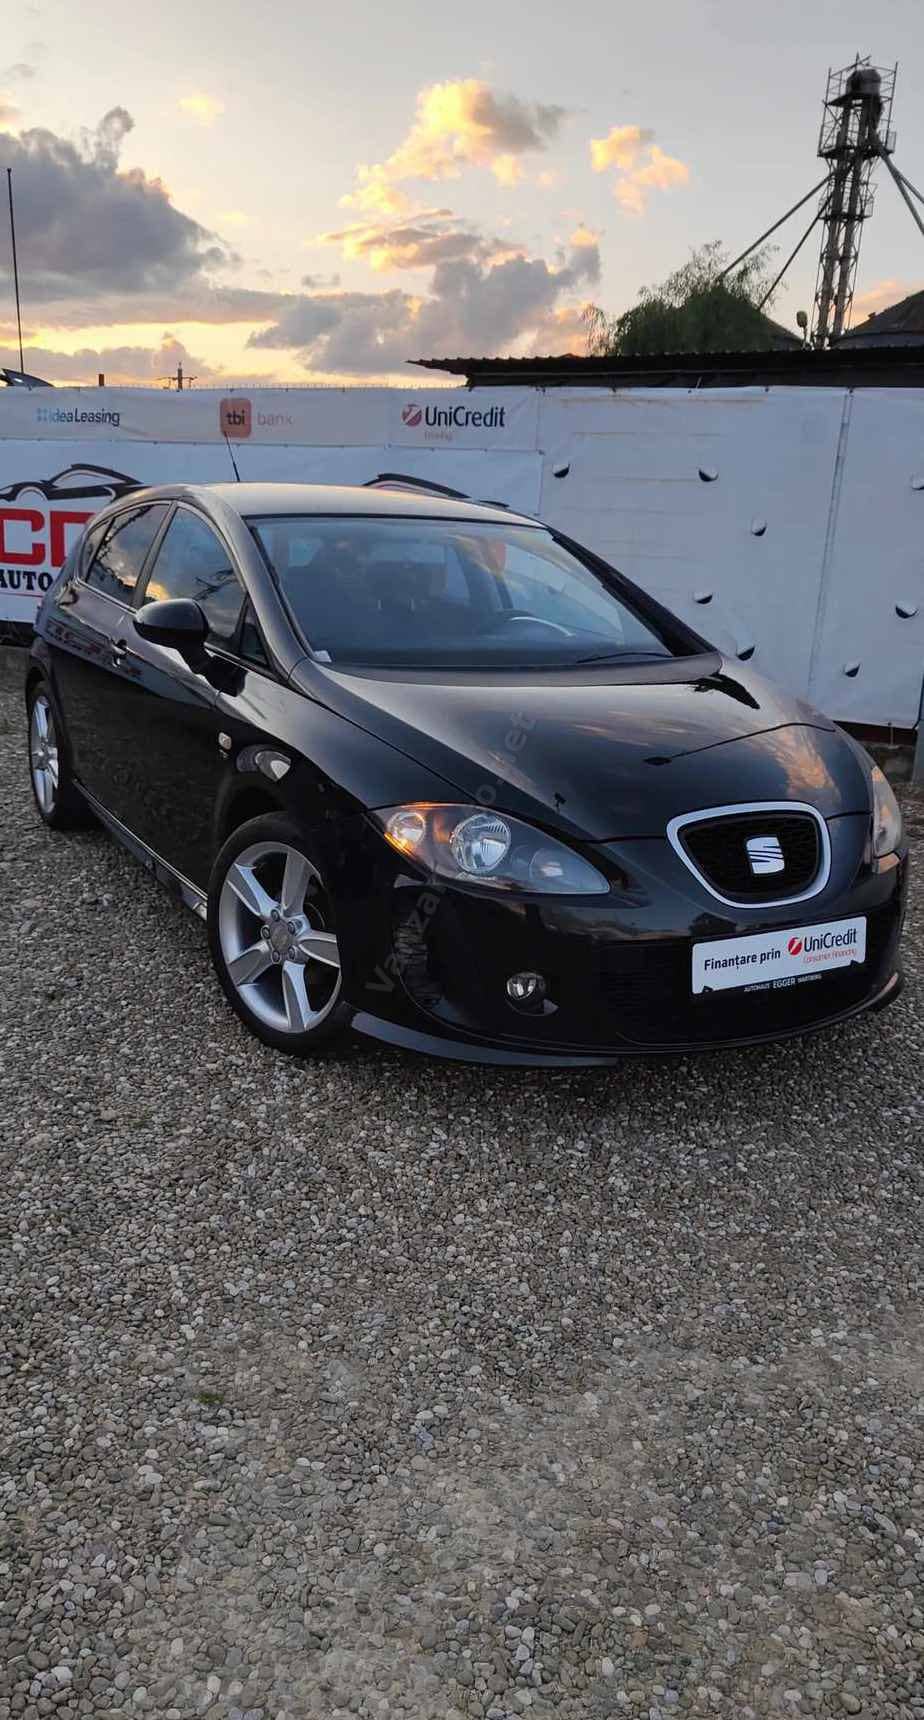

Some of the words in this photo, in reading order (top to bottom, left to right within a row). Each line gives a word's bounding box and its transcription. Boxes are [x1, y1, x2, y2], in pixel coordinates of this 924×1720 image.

[225, 409, 246, 425] tbi
[424, 405, 506, 428] UniCredit
[803, 928, 858, 953] UniCredit
[703, 954, 758, 971] Finanțare
[760, 948, 781, 965] prin
[772, 977, 796, 989] EGGER
